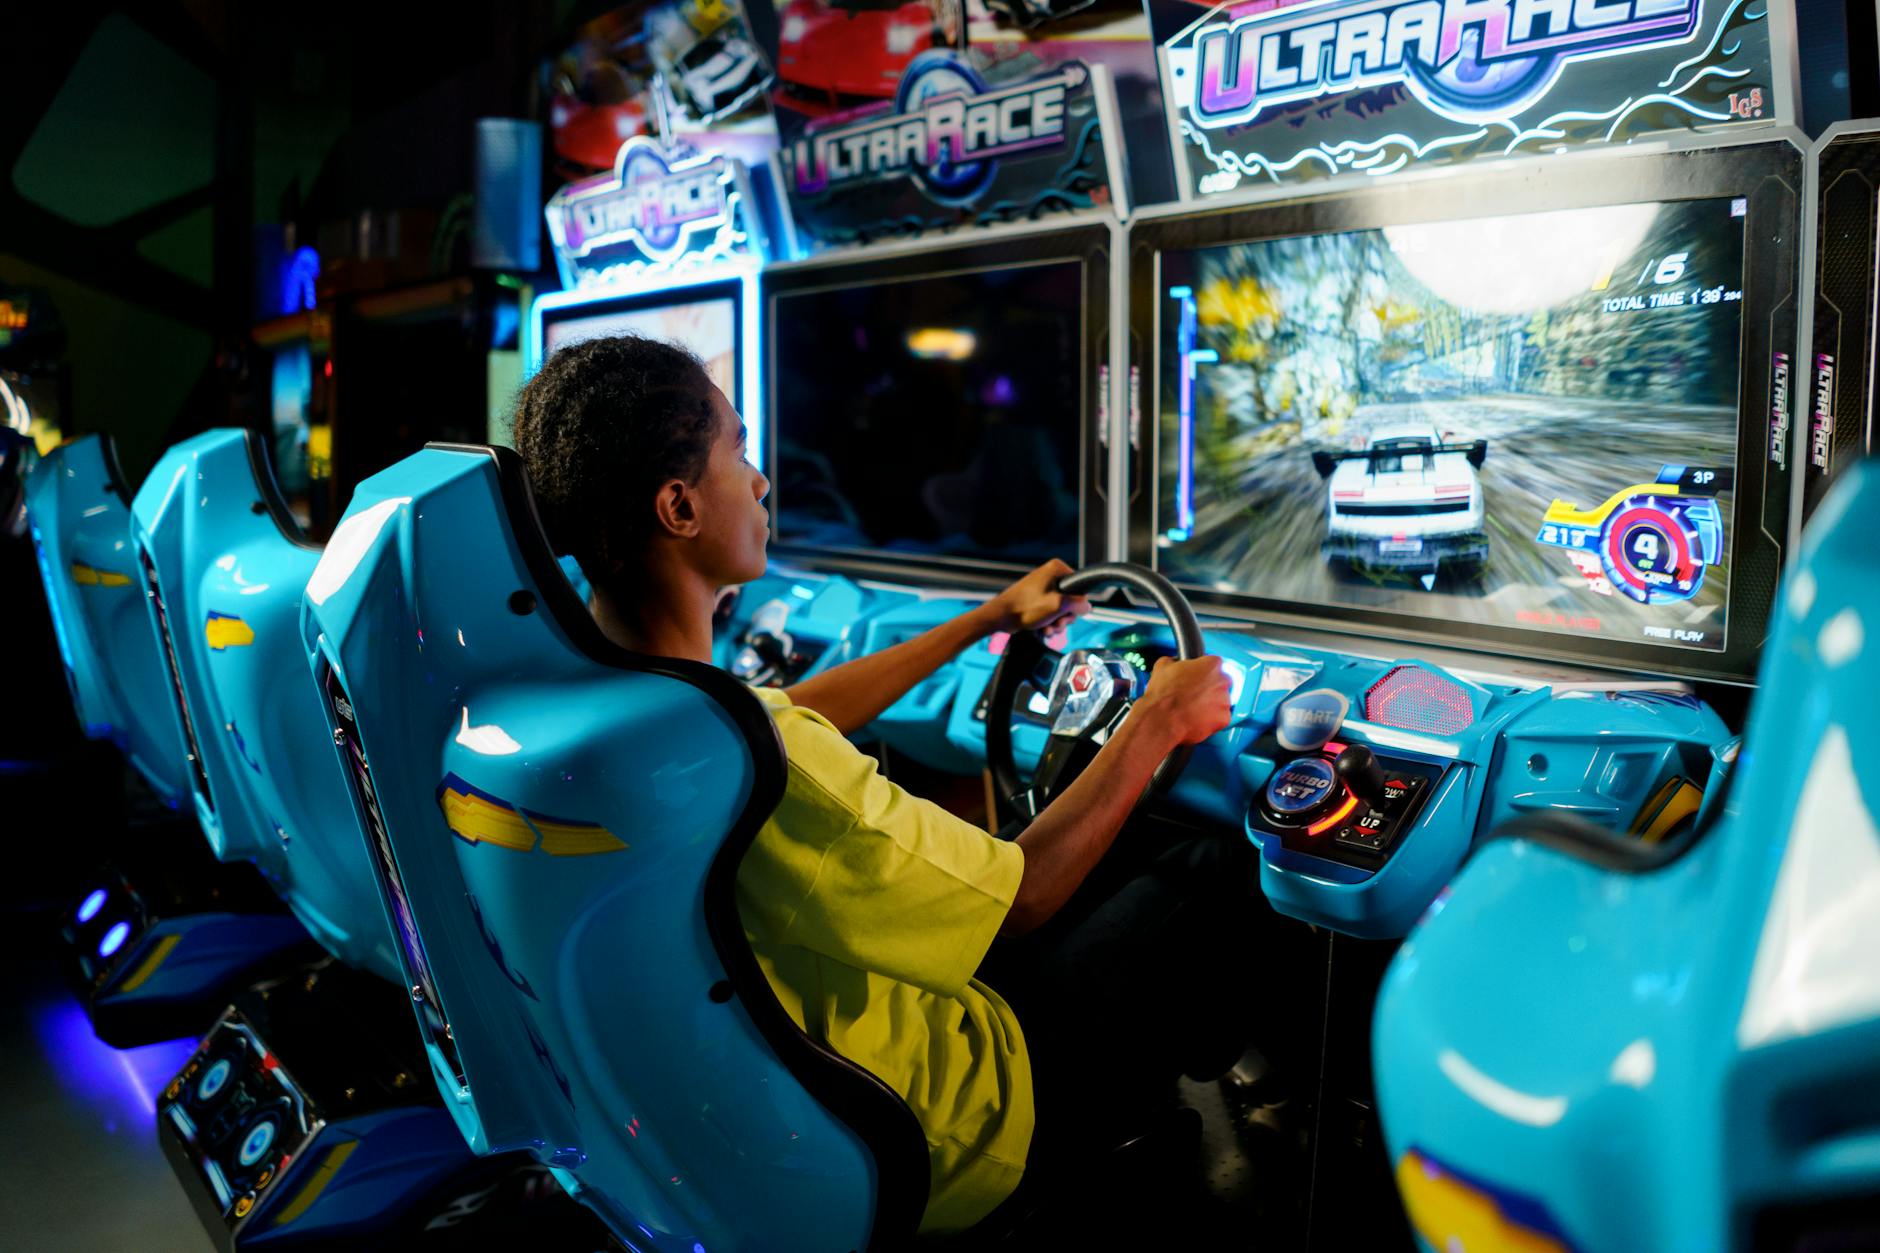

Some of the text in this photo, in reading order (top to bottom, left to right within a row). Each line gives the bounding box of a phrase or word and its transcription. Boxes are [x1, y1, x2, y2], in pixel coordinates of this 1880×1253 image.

[1602, 296, 1646, 312] TOTAL
[1650, 291, 1684, 308] TIME
[1693, 471, 1714, 484] 3P
[1634, 533, 1658, 560] 4
[1644, 626, 1704, 641] FREE PLAY
[1285, 707, 1334, 725] START
[1281, 771, 1330, 789] TURBO
[1360, 817, 1380, 828] UP
